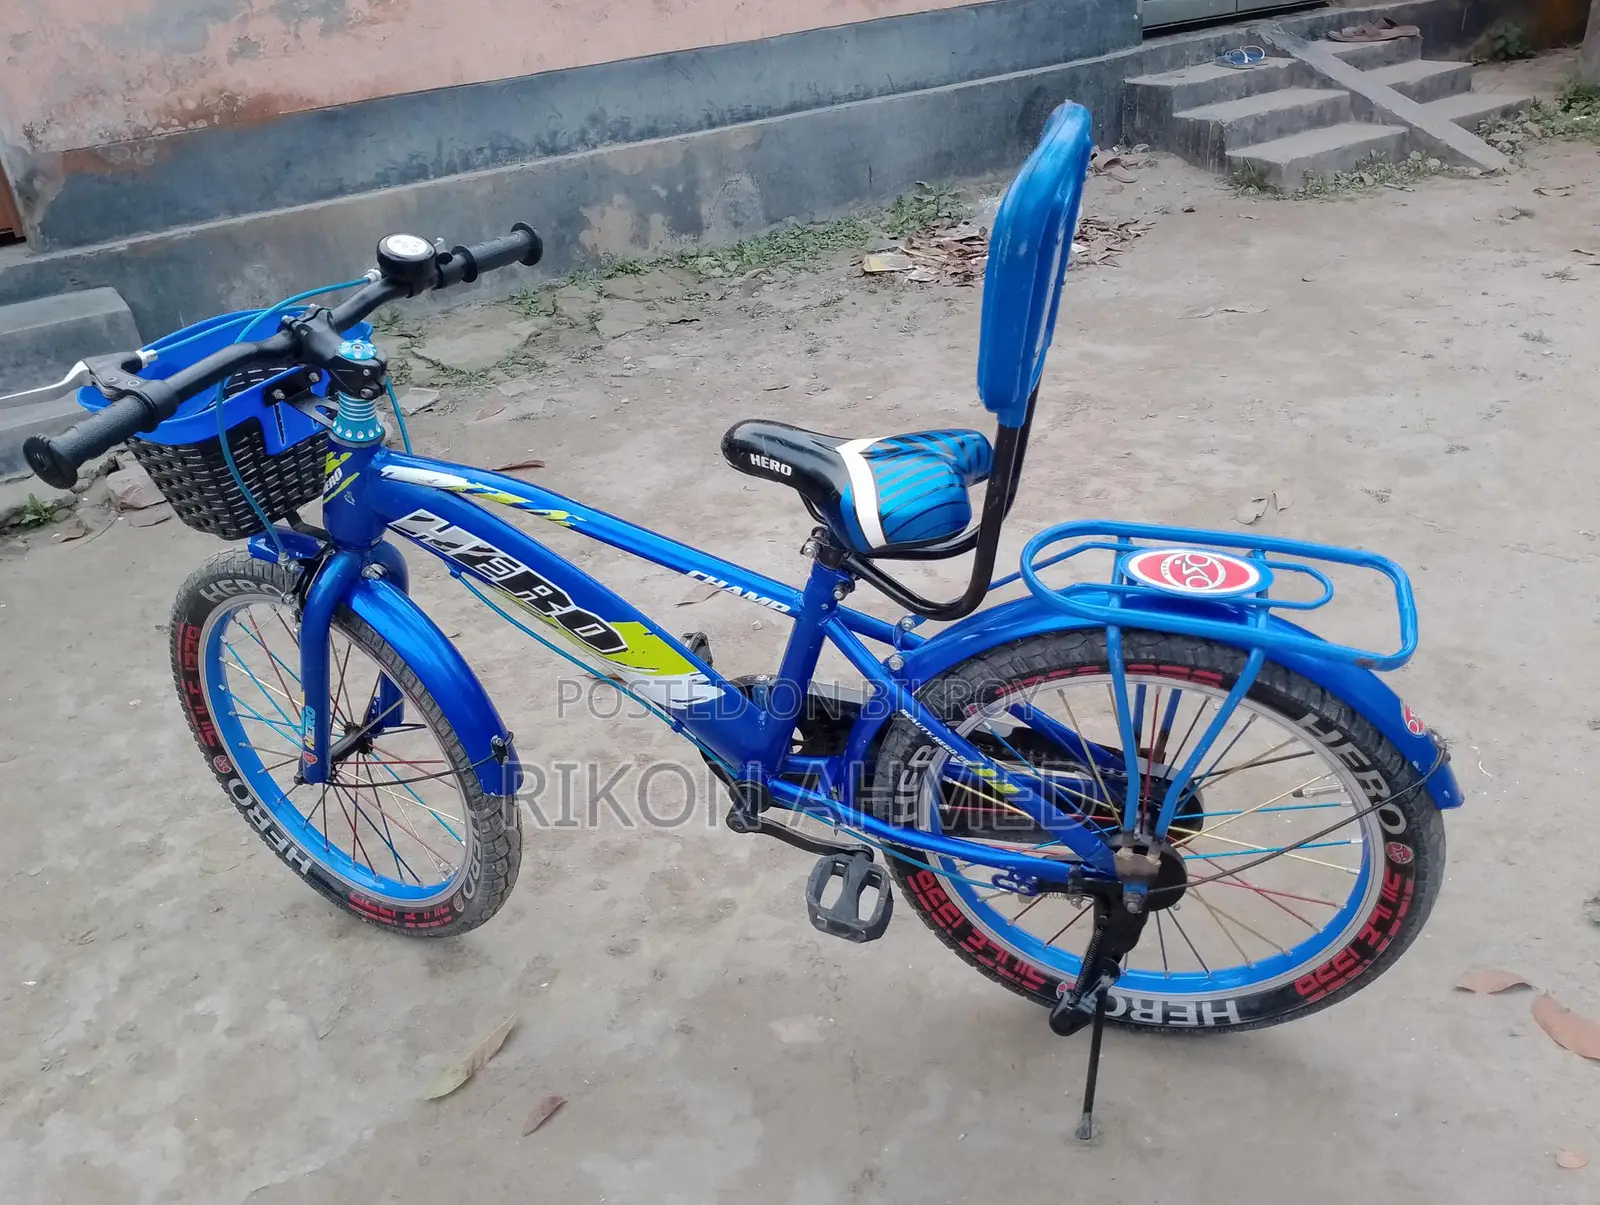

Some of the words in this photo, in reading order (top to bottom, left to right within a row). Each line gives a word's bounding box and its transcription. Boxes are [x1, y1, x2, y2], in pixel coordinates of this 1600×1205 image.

[323, 467, 343, 493] ERO
[750, 453, 792, 477] HERO
[199, 577, 285, 603] HERO
[388, 508, 628, 654] HERO
[686, 570, 791, 613] CHAMP
[896, 744, 939, 823] HER
[1299, 711, 1408, 836] HERO
[228, 777, 311, 875] HERO
